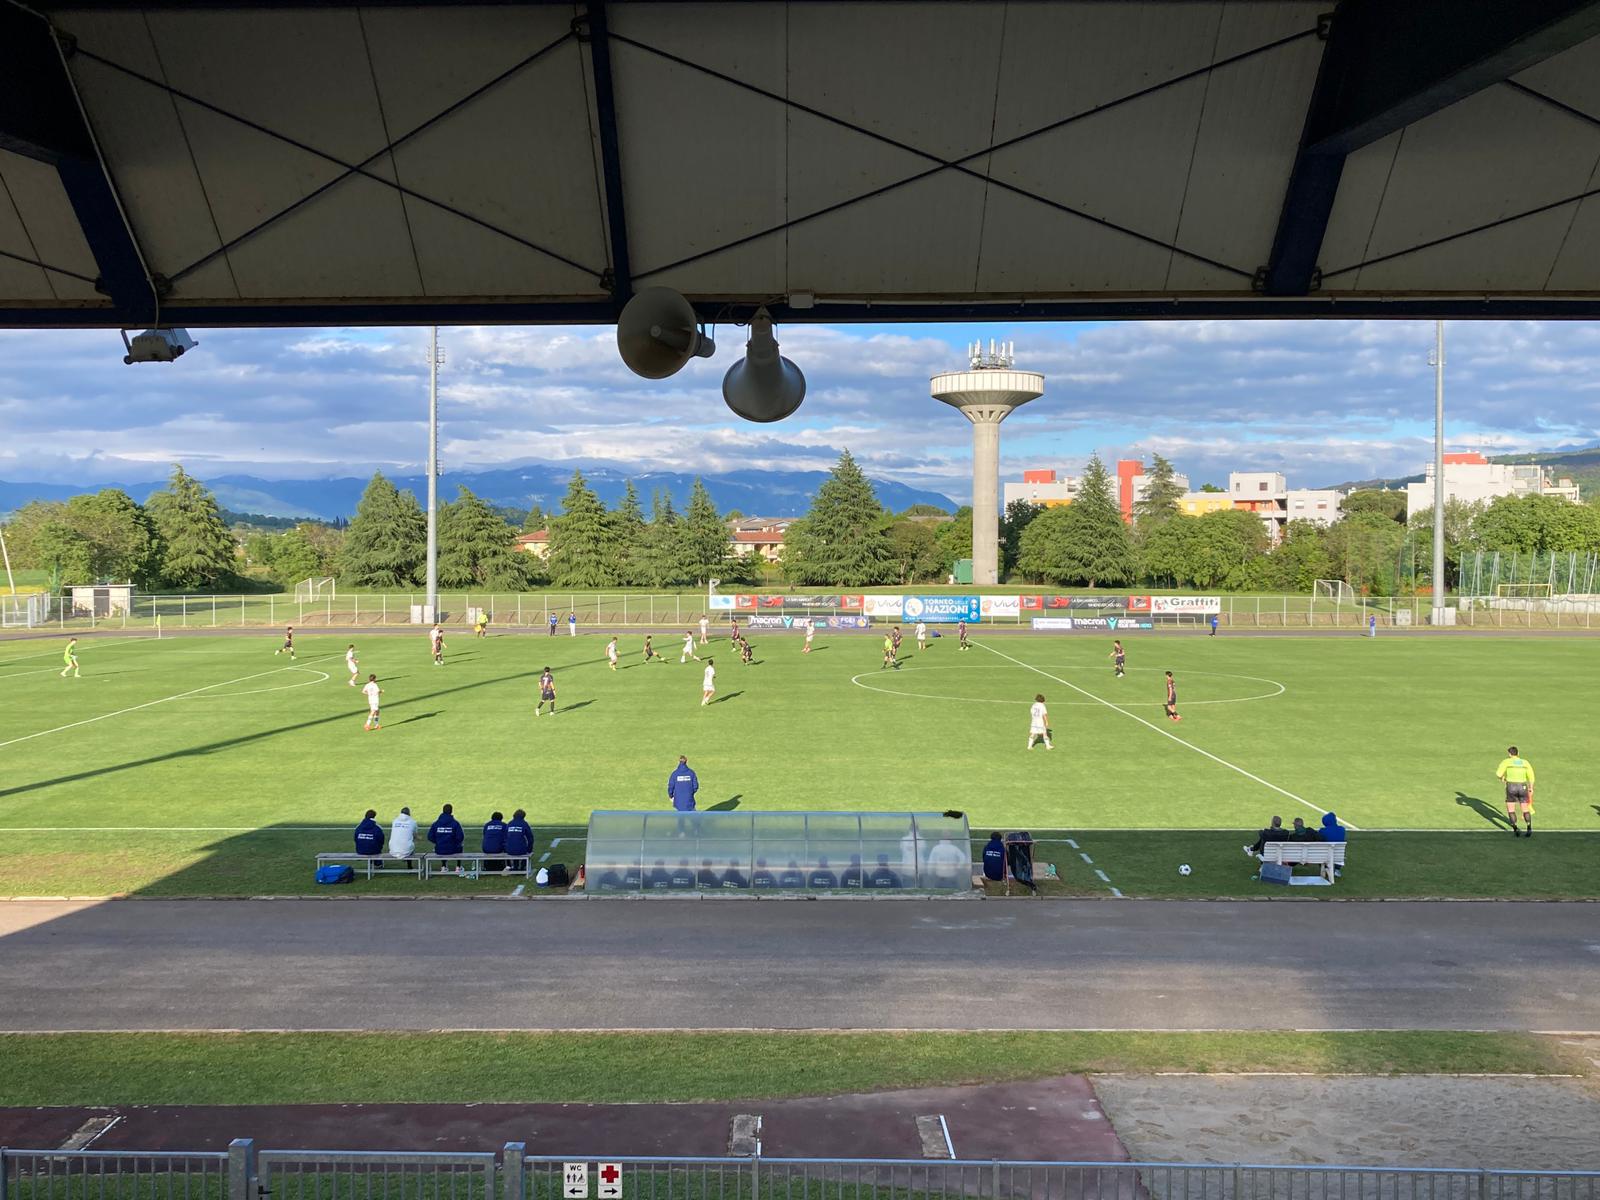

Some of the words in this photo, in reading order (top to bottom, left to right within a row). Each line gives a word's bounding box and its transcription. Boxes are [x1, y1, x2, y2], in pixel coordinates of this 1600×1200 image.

[1170, 598, 1219, 606] Graffiti
[925, 605, 968, 614] NAZIONI
[1074, 618, 1107, 626] macron
